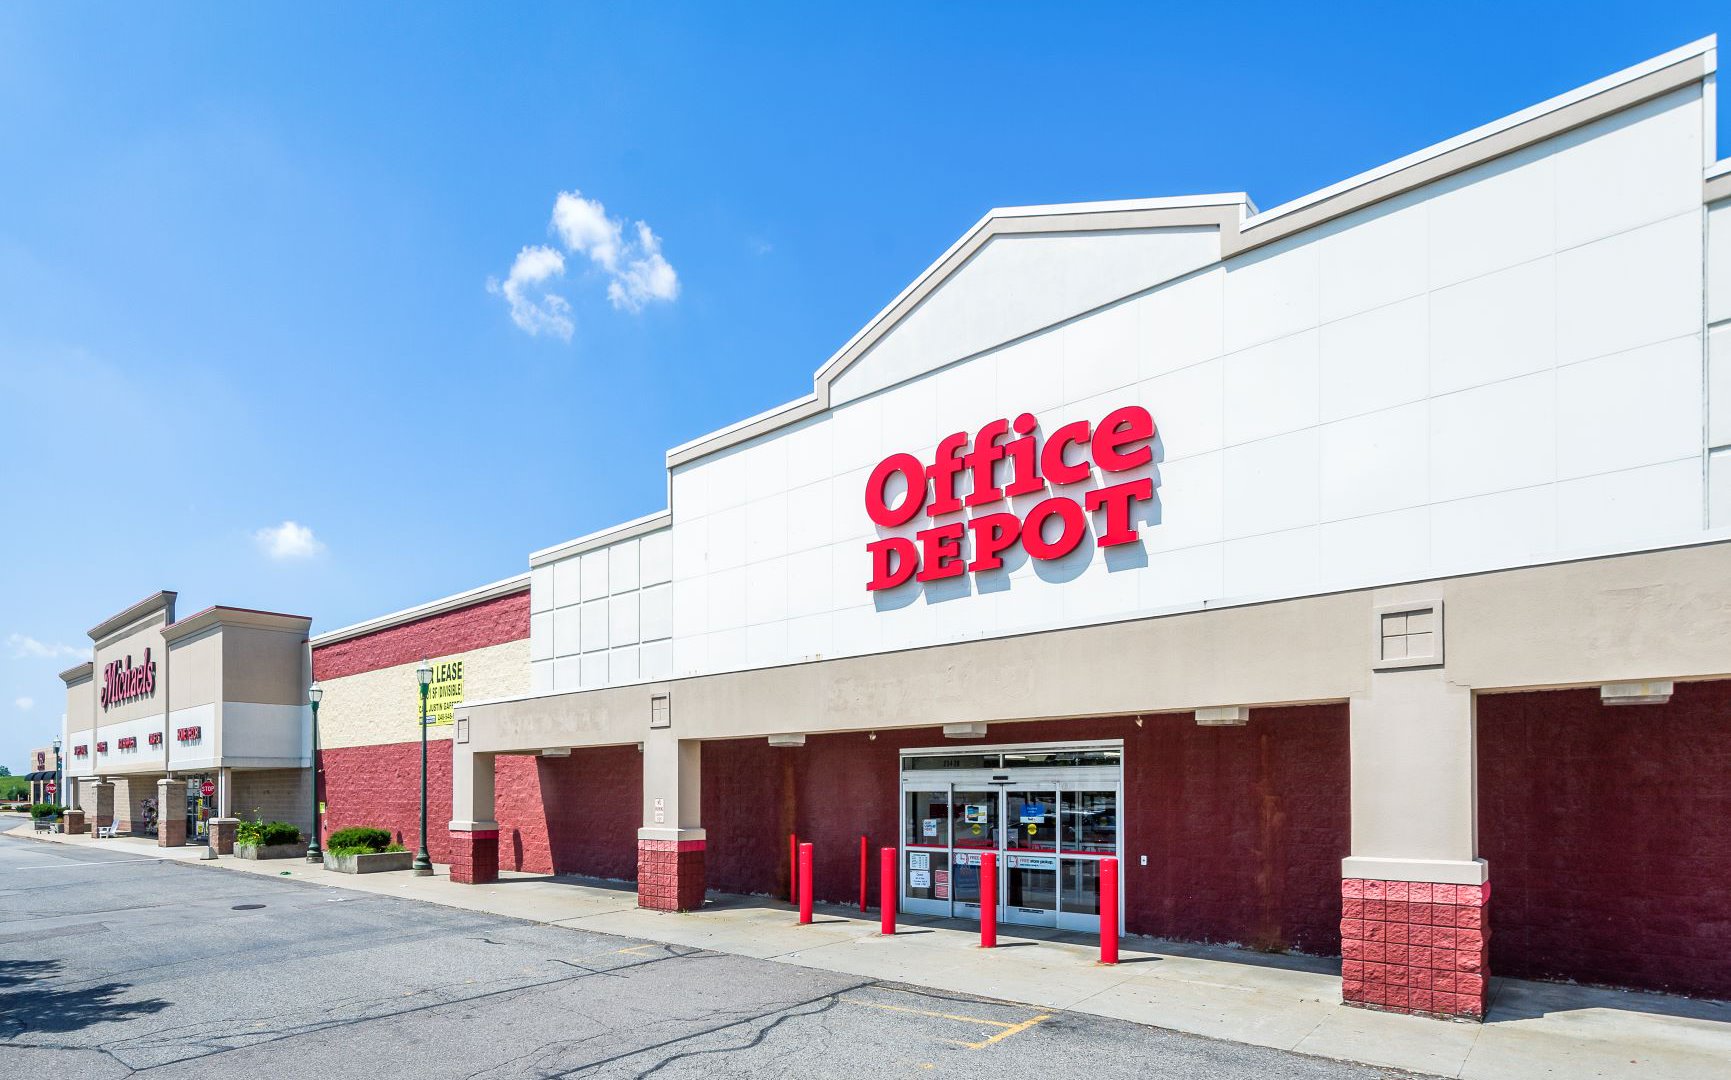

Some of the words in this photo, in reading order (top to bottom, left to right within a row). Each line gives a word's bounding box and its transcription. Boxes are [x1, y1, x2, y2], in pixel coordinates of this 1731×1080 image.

[865, 406, 1155, 527] Office
[866, 478, 1152, 591] DEPOT
[101, 647, 156, 708] Michaels
[437, 661, 462, 683] LEASE
